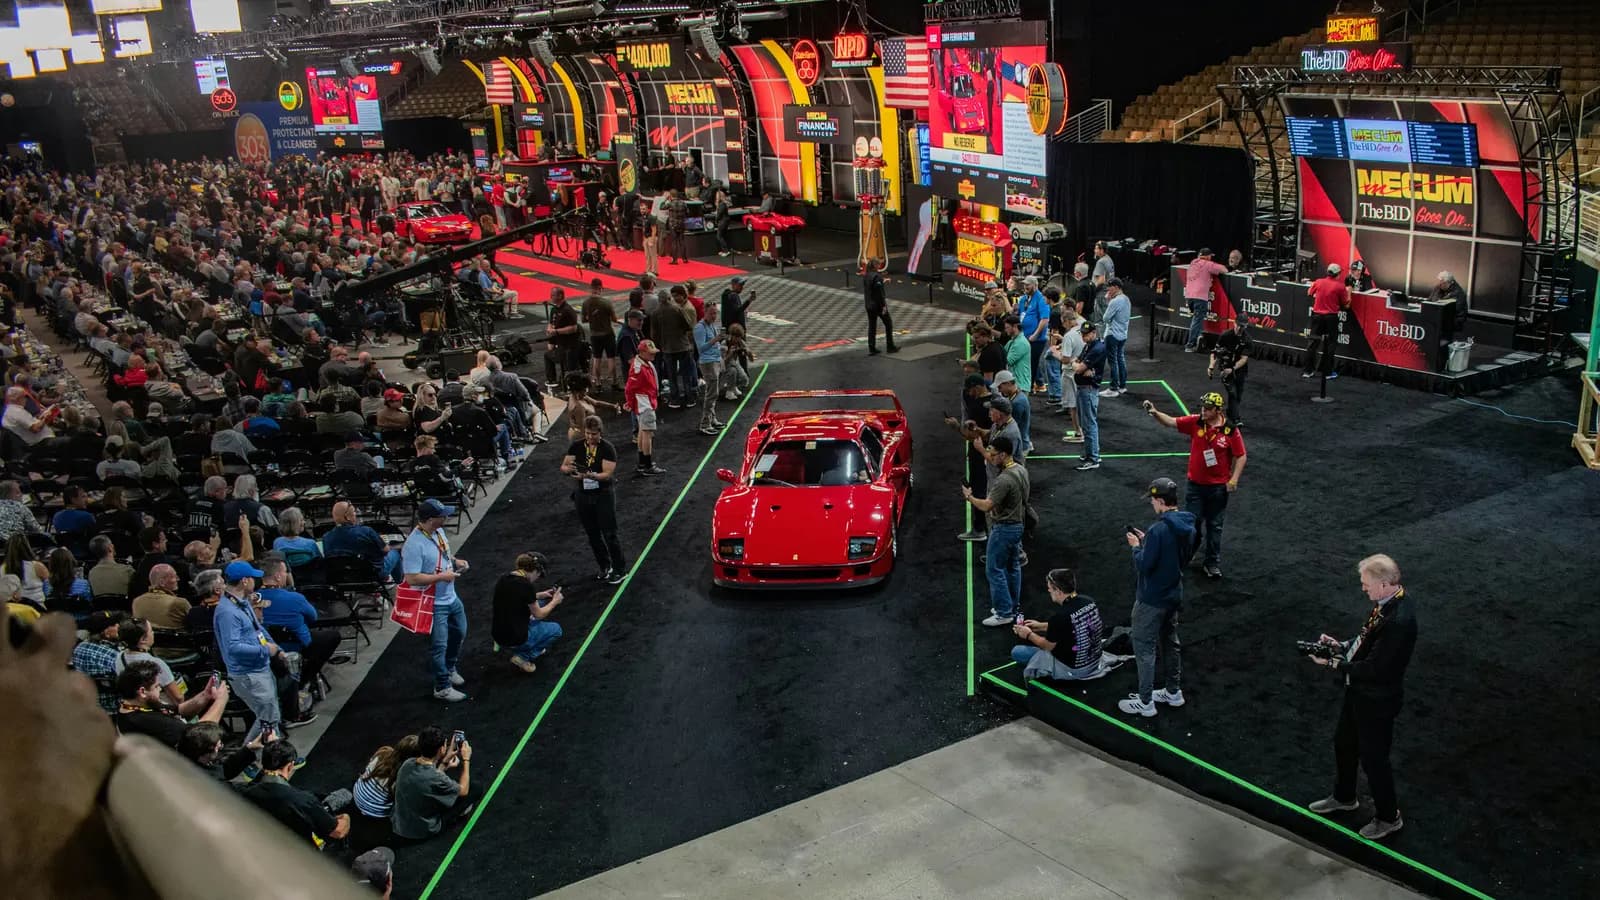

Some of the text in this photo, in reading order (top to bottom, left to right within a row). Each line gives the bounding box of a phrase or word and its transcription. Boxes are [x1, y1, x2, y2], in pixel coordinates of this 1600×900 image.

[1327, 18, 1378, 43] MECUM
[834, 35, 867, 59] NPD
[1346, 49, 1371, 72] Goes
[214, 94, 233, 105] 303
[664, 84, 717, 104] MECUM
[669, 104, 719, 114] AUCTIONS
[279, 116, 309, 126] PREMIUM
[798, 121, 837, 131] FINANCIAL
[1351, 128, 1403, 143] MECUM
[282, 139, 318, 149] CLEANERS
[1008, 175, 1032, 185] DODGE
[1357, 168, 1473, 205] MECUM
[1416, 206, 1443, 224] Goes
